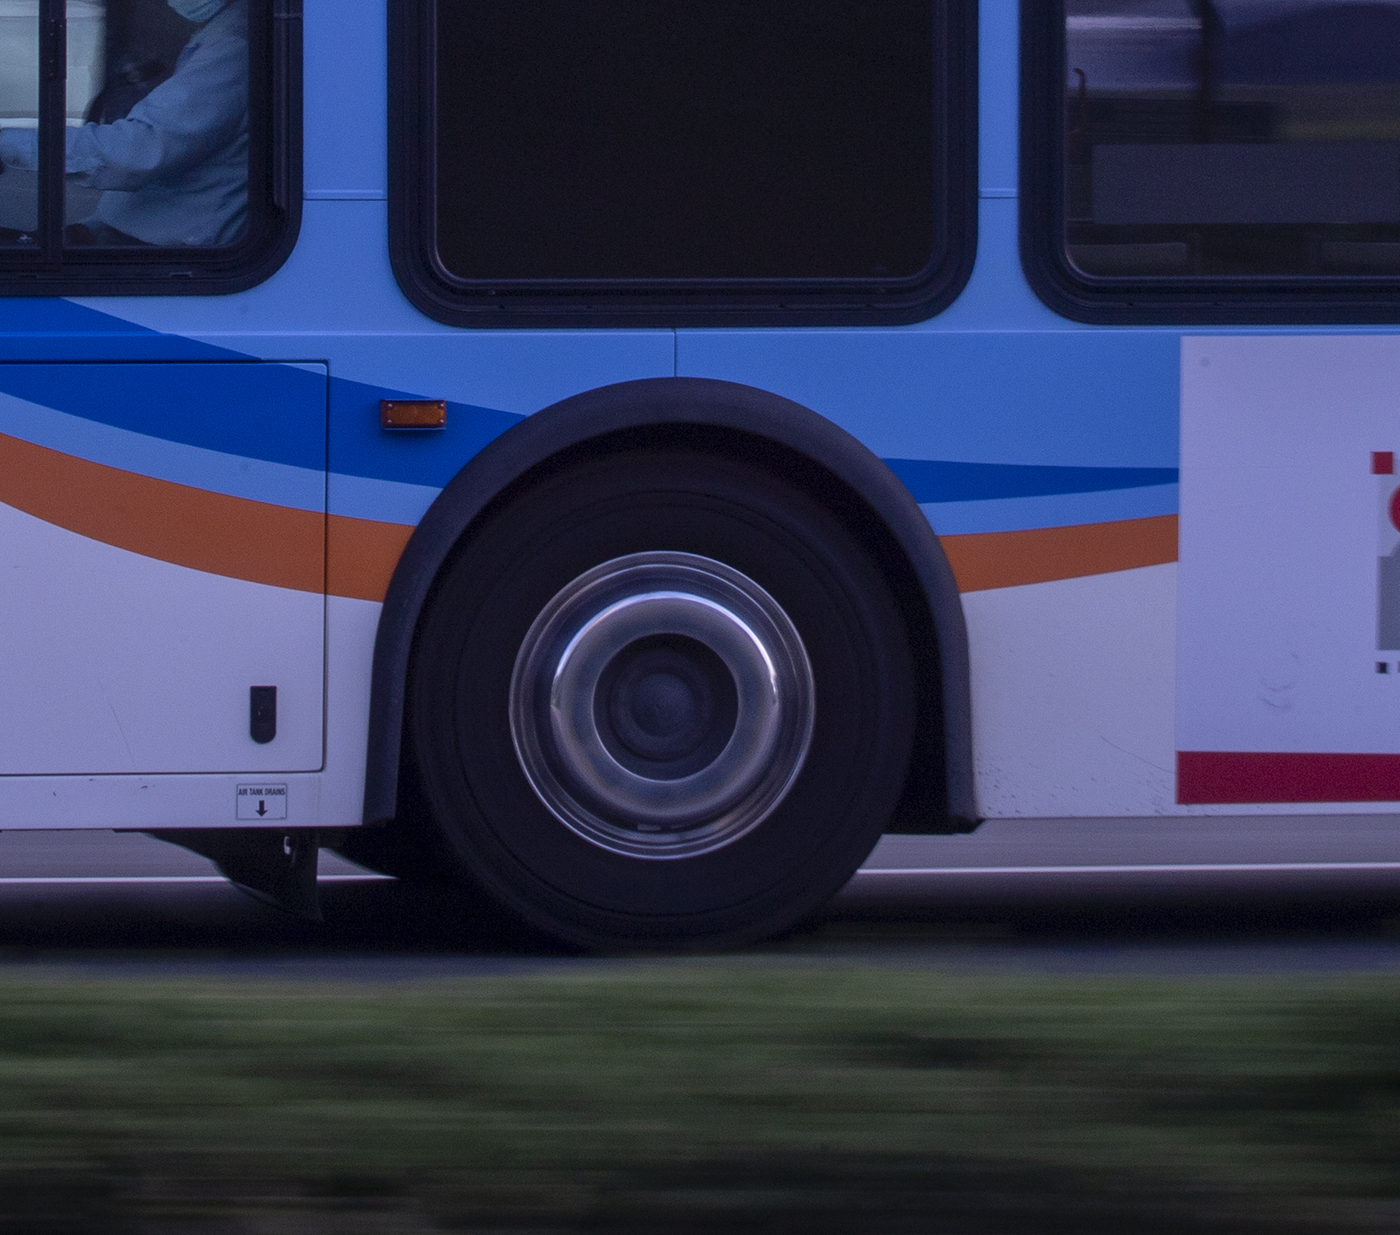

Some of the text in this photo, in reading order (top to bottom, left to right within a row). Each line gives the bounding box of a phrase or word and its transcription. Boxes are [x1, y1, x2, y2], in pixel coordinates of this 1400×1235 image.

[238, 788, 285, 796] AIR TANK DRAINS
